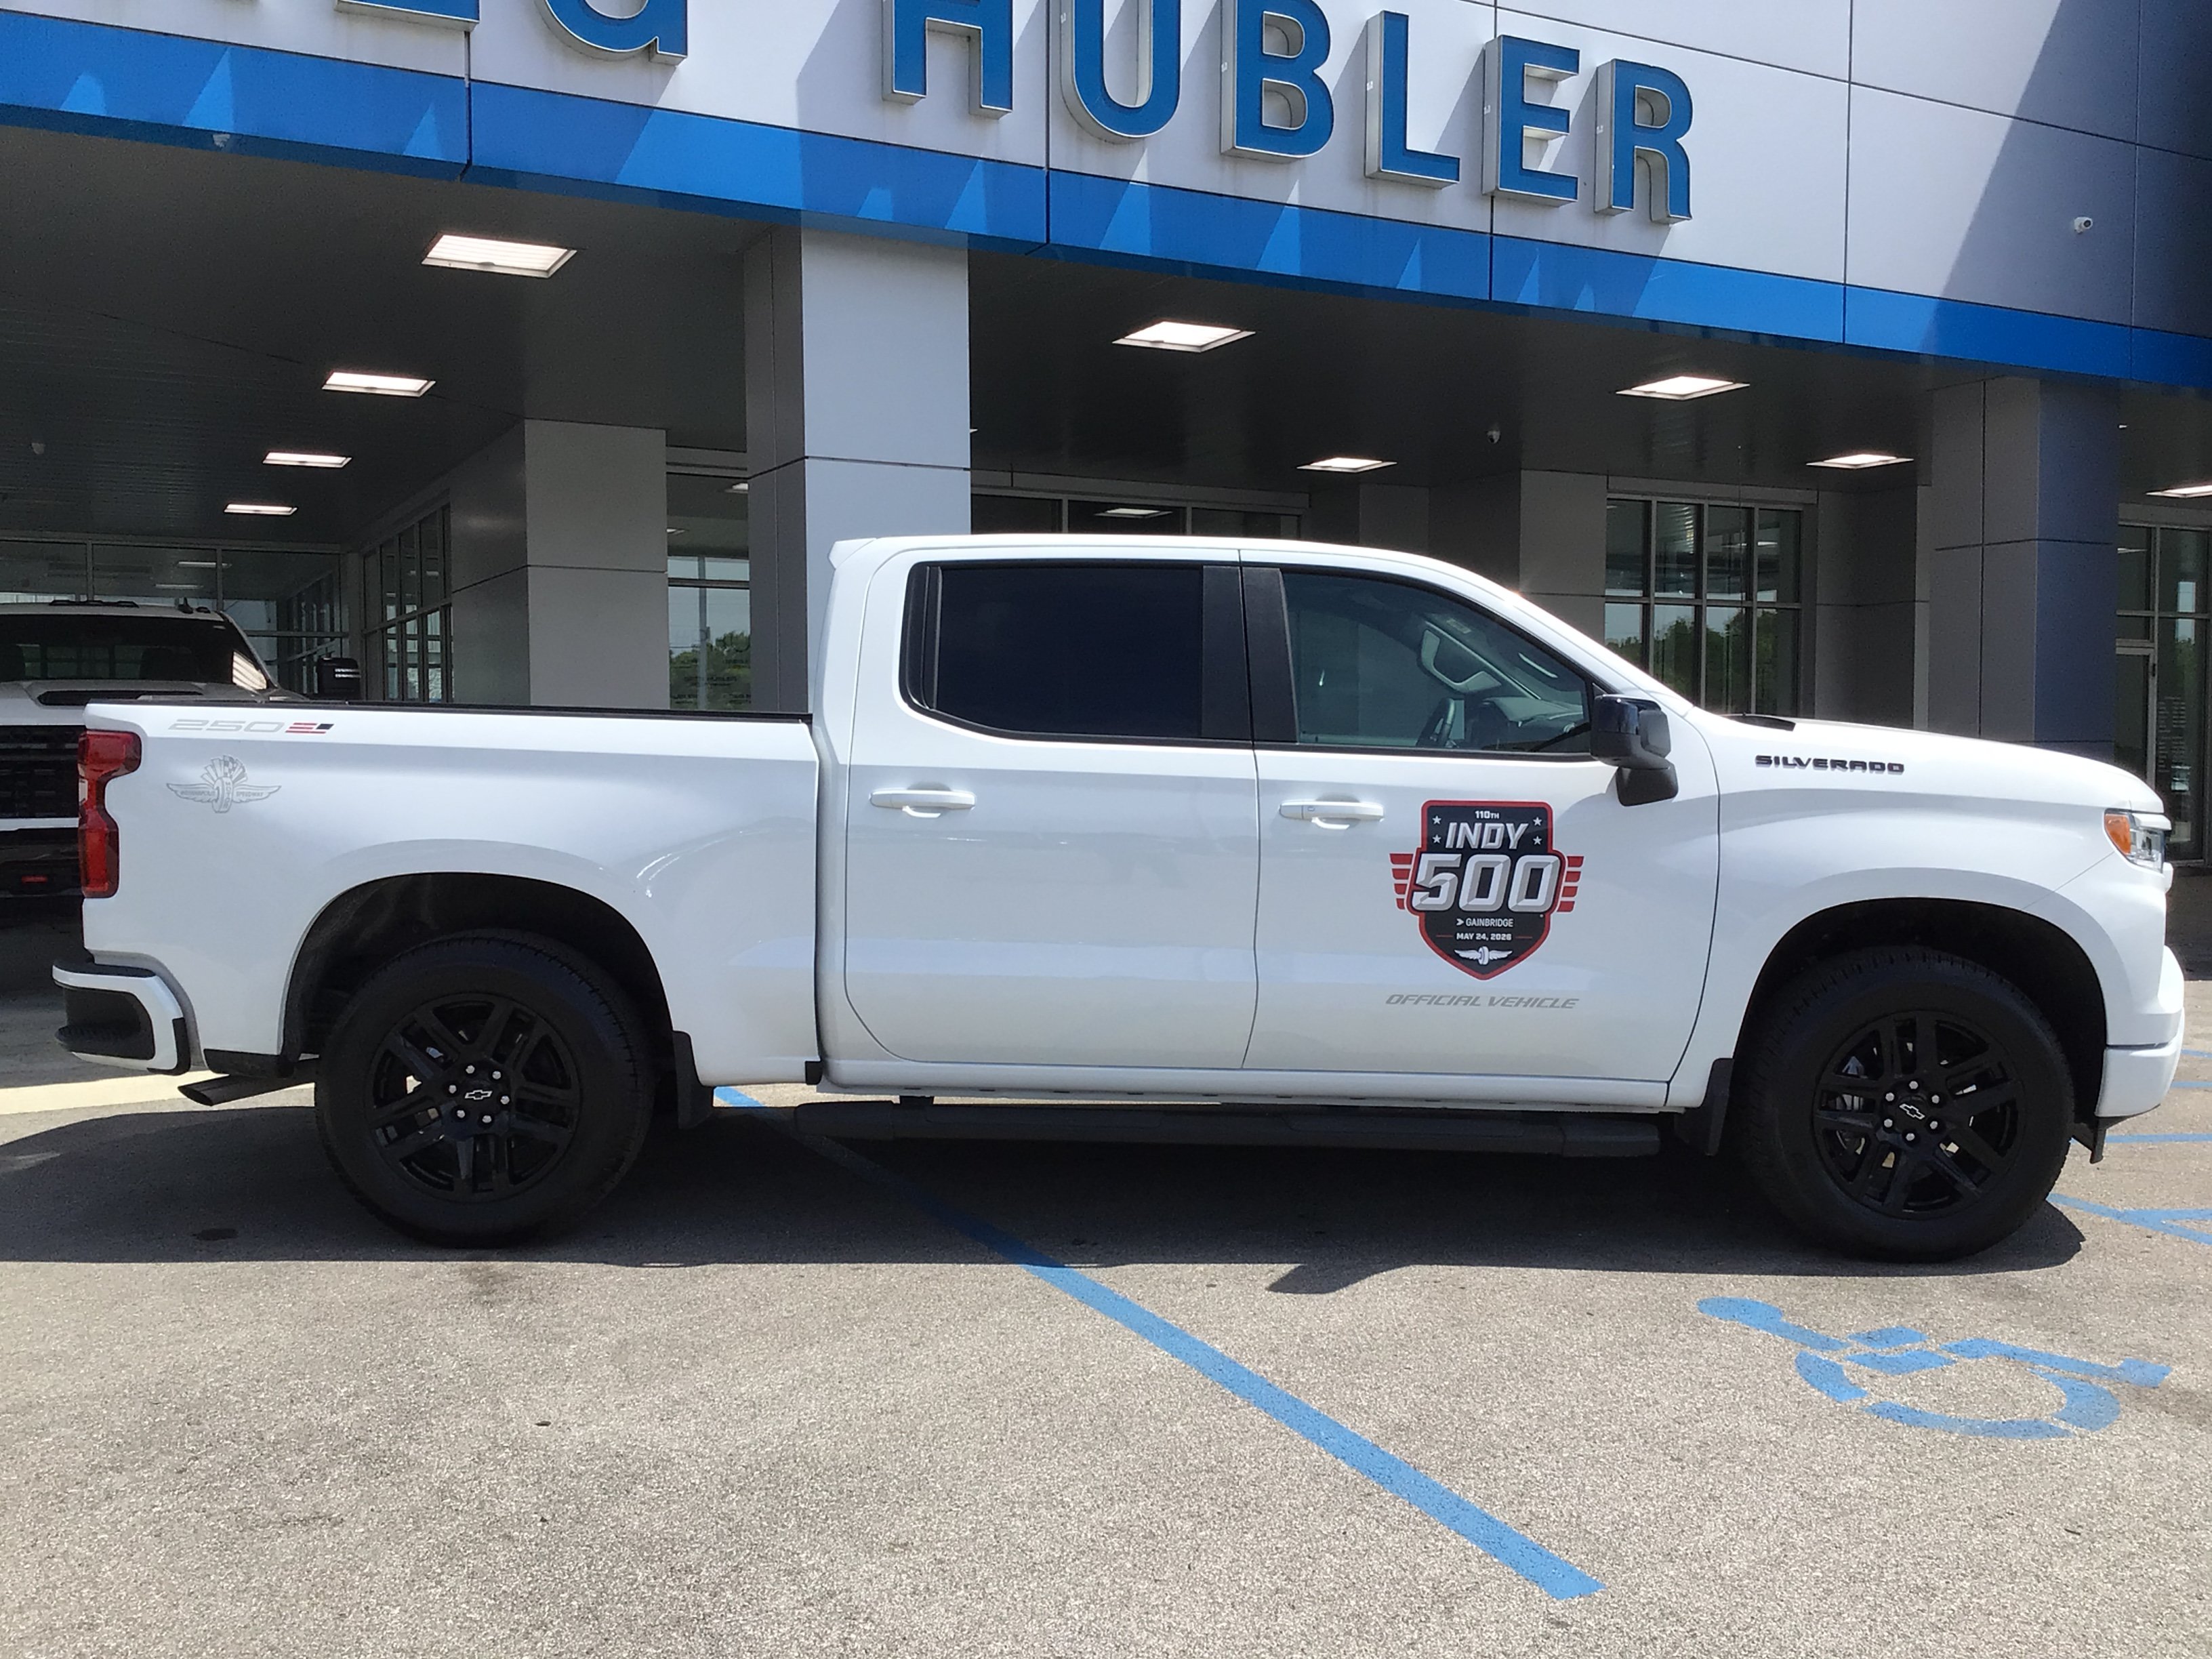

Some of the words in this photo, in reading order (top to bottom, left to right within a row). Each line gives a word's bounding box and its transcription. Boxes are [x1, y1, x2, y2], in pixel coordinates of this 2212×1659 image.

[883, 0, 1693, 224] HUBLER
[167, 718, 285, 733] 250
[1755, 754, 1905, 775] SILVERADO
[1475, 810, 1500, 819] 110TH
[1445, 822, 1530, 850] INDY
[1411, 853, 1561, 912] 500
[1465, 918, 1514, 928] GAINBRIDGE
[1476, 933, 1489, 941] 24,
[1385, 994, 1481, 1006] OFFICIAL
[1488, 996, 1580, 1009] VEHICLE
